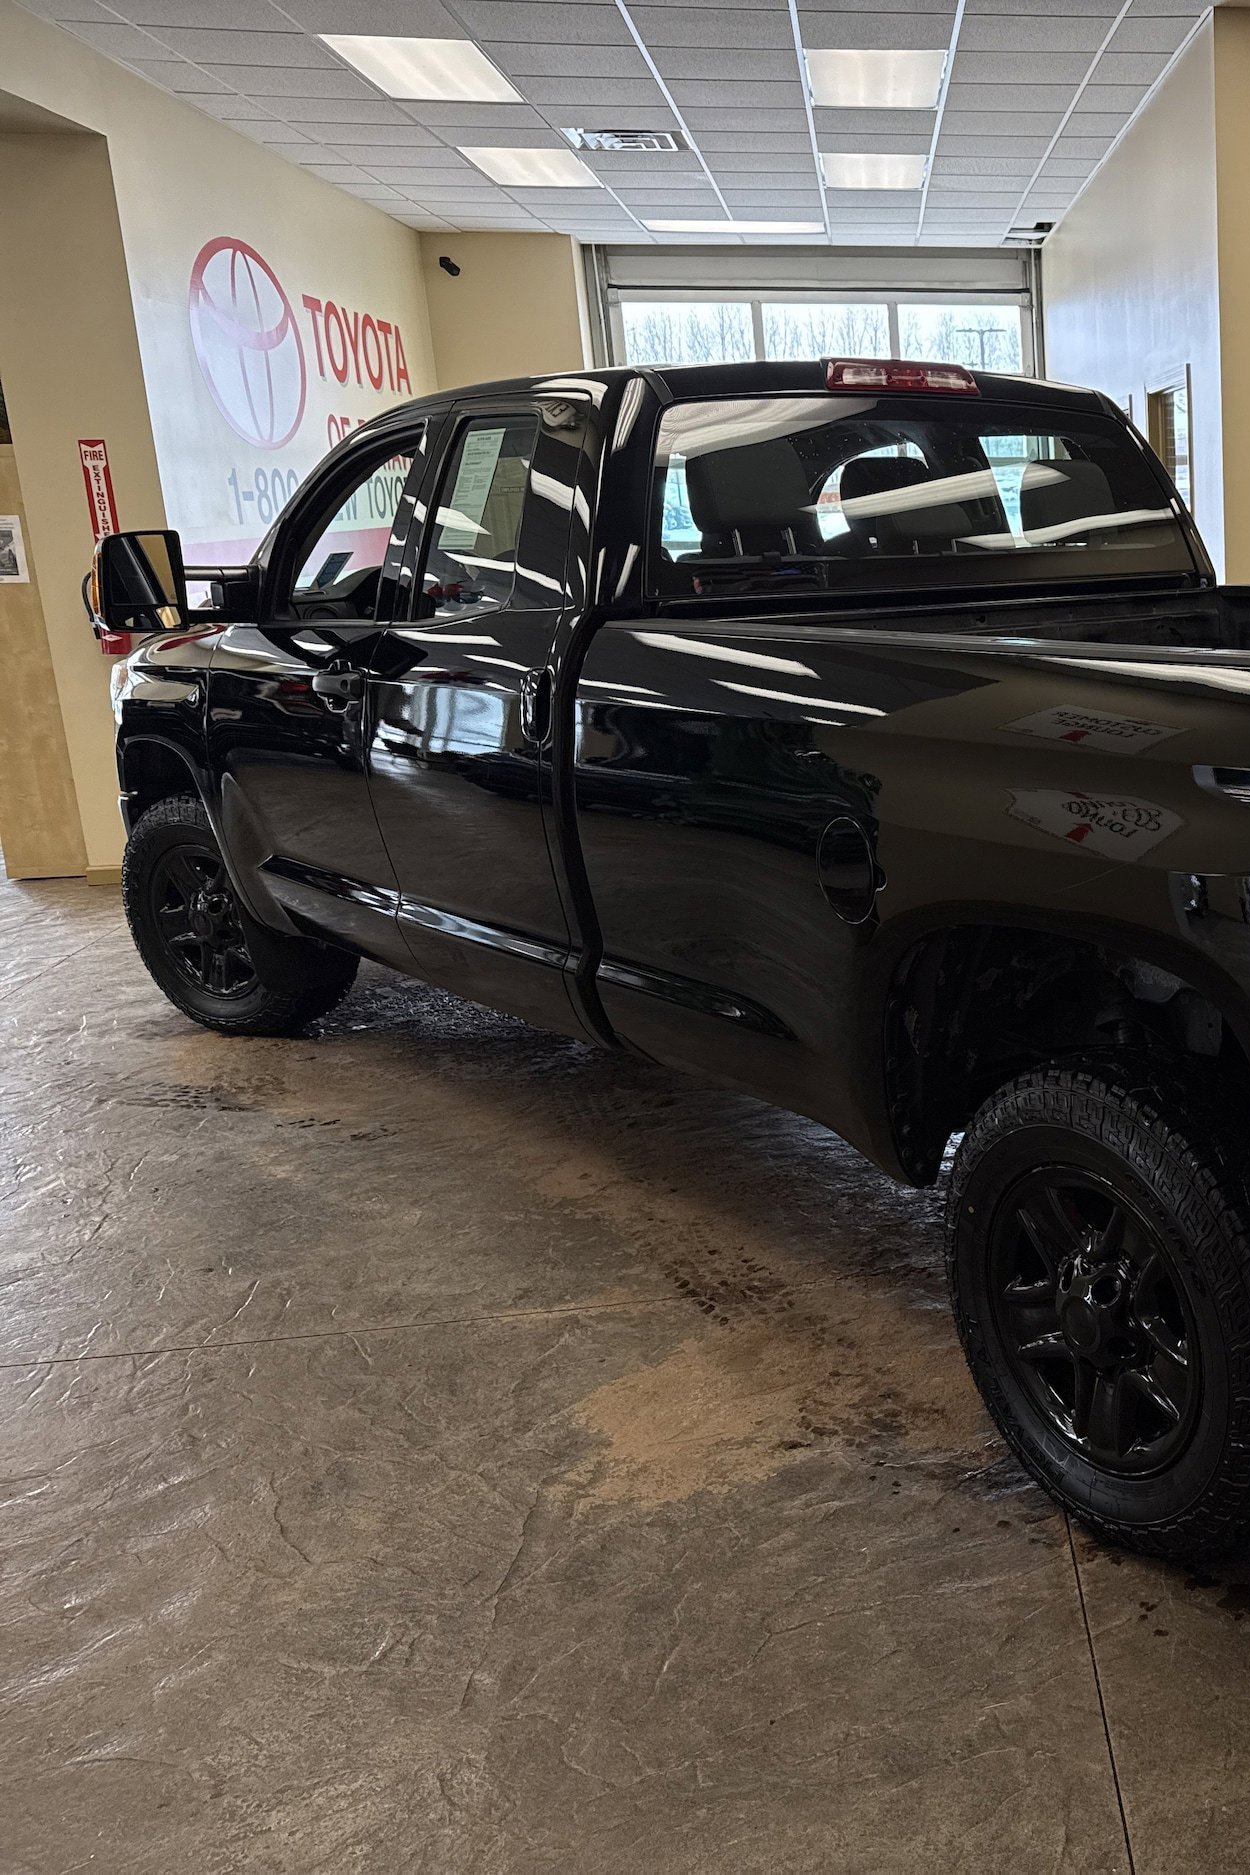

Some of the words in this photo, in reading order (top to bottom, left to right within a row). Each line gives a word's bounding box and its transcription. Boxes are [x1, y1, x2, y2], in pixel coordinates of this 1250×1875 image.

[302, 293, 412, 396] TOYOTA
[83, 450, 104, 461] FIRE
[365, 475, 408, 520] TOYO
